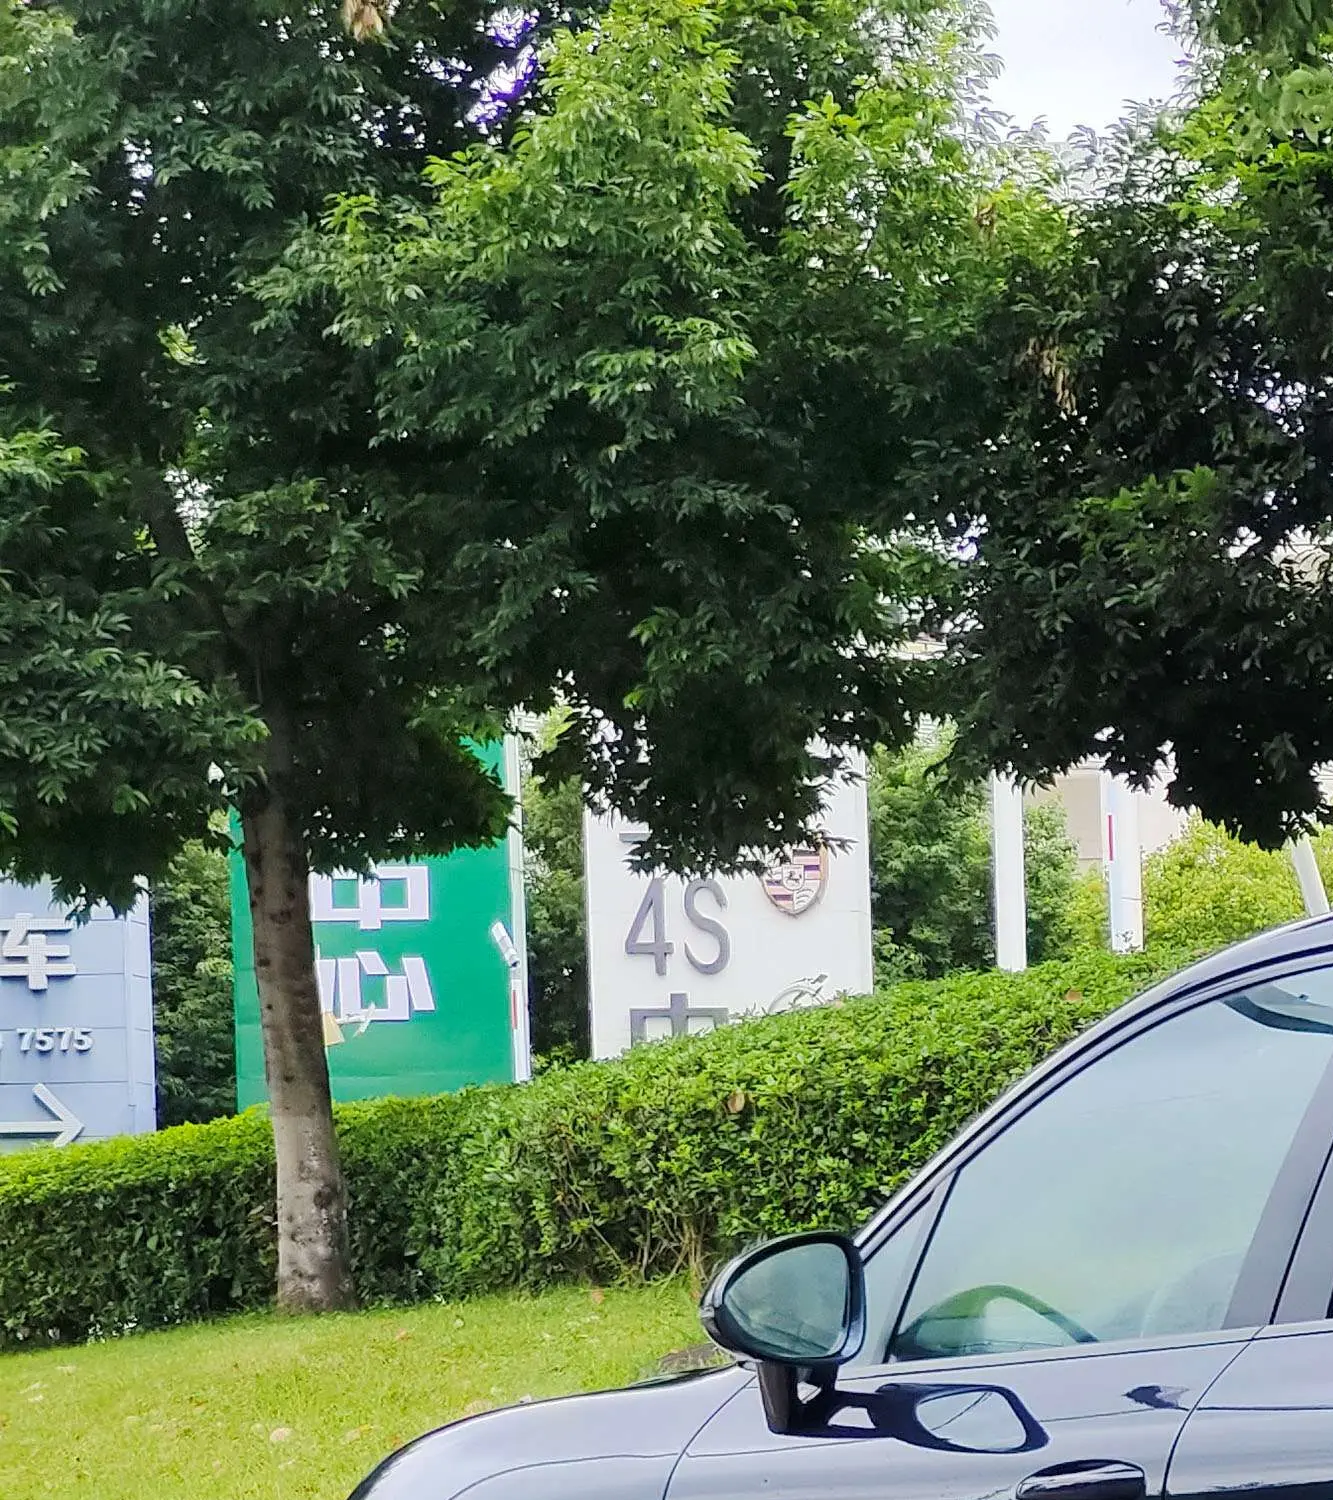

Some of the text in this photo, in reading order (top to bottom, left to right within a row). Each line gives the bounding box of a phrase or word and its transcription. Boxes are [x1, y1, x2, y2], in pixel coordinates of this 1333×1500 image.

[0, 913, 77, 990] 车
[624, 877, 731, 977] 4S
[16, 1027, 93, 1052] 7575
